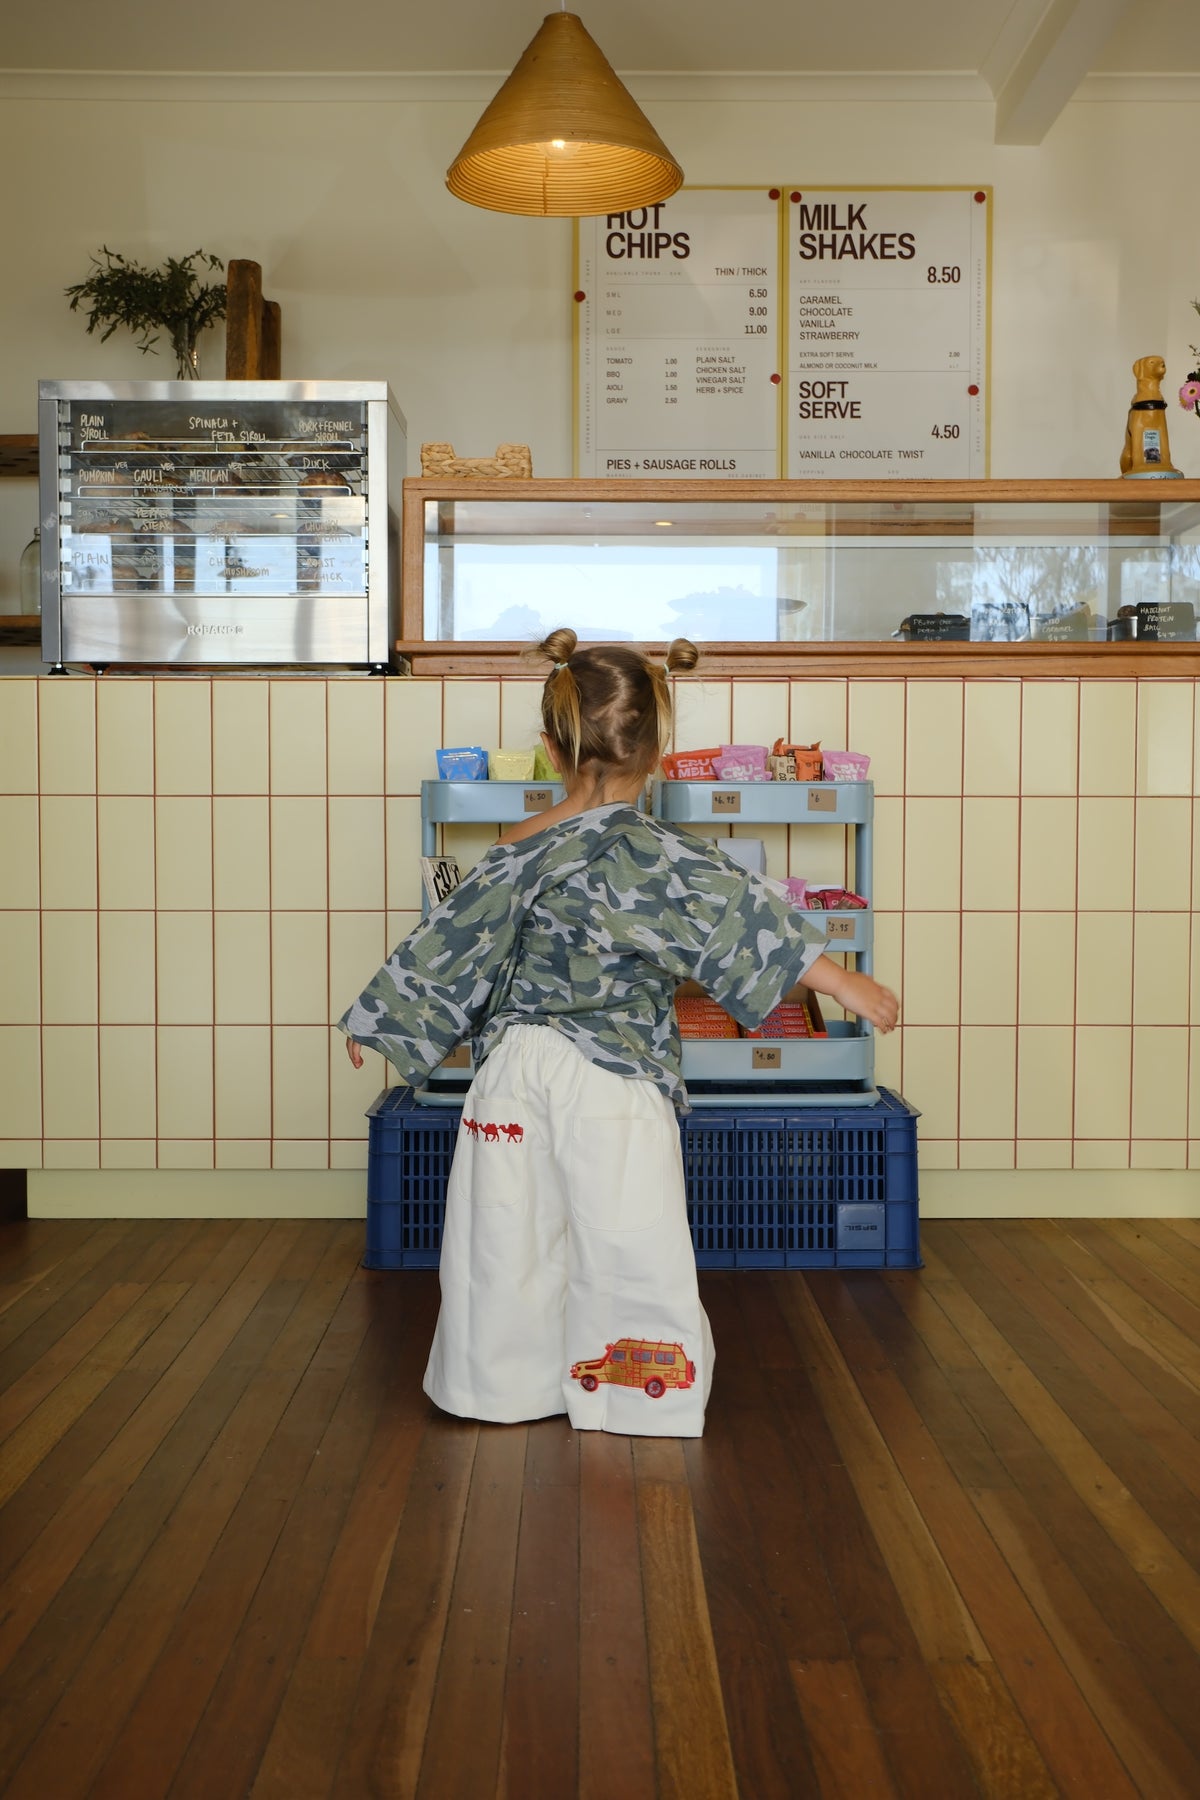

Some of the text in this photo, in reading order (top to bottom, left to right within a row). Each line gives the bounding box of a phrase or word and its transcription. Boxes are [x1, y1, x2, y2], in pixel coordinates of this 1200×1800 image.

[606, 203, 666, 229] HOT
[800, 204, 867, 230] MILK
[606, 232, 690, 259] CHIPS
[799, 233, 915, 260] SHAKES
[735, 267, 741, 277] /
[742, 268, 767, 276] THICK
[928, 266, 960, 283] 8.50
[749, 289, 767, 298] 6.50
[800, 296, 841, 304] CARAMEL
[749, 307, 767, 316] 9.00
[800, 308, 852, 316] CHOCOLATE
[800, 320, 835, 328] VANILLA
[745, 325, 767, 334] 11.00
[800, 332, 859, 340] STRAWBERRY
[606, 358, 634, 366] TOMATO
[664, 357, 678, 365] 1.00
[696, 356, 736, 364] PLAIN SALT
[606, 370, 621, 378] BBQ
[664, 370, 678, 378] 1.00
[696, 366, 746, 374] CHICKEN SALT
[696, 376, 746, 384] VINEGAR SALT
[696, 386, 716, 394] HERB
[723, 386, 744, 394] SPICE
[799, 381, 848, 399] SOFT
[799, 401, 861, 419] SERVE
[80, 414, 104, 427] PLAIN
[189, 416, 238, 430] SPINACH +
[211, 430, 235, 441] FETA
[932, 425, 959, 438] 4.50
[840, 450, 892, 459] CHOCOLATE
[898, 450, 924, 458] TWIST
[607, 459, 631, 469] PIES
[643, 460, 696, 469] SAUSAGE
[700, 460, 736, 470] ROLLS
[79, 469, 114, 483] PUMPKIN
[134, 469, 163, 483] CAULI
[189, 469, 229, 483] MEXICAN
[142, 520, 170, 531] STEAK
[74, 552, 109, 565] PLAIN
[223, 567, 270, 577] MUSHROOM
